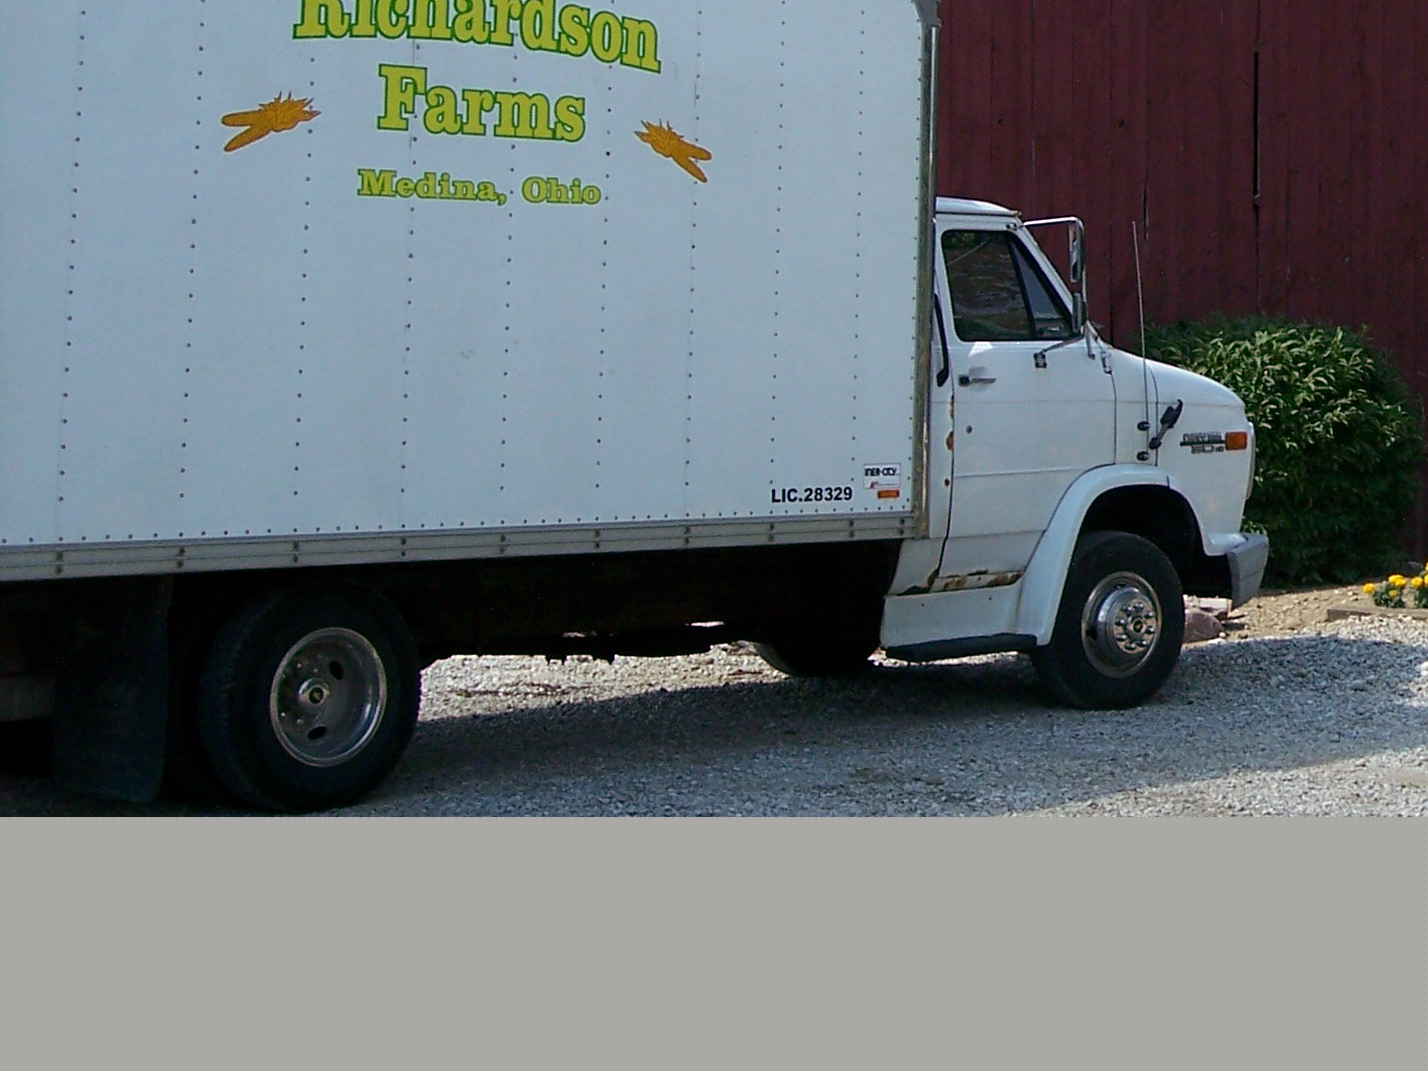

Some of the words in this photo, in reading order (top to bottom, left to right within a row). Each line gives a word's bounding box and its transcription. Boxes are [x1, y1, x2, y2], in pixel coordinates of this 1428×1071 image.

[377, 64, 585, 142] Farms
[357, 168, 506, 205] Medina,
[522, 177, 600, 205] Ohio
[771, 486, 853, 503] LIC.28329
